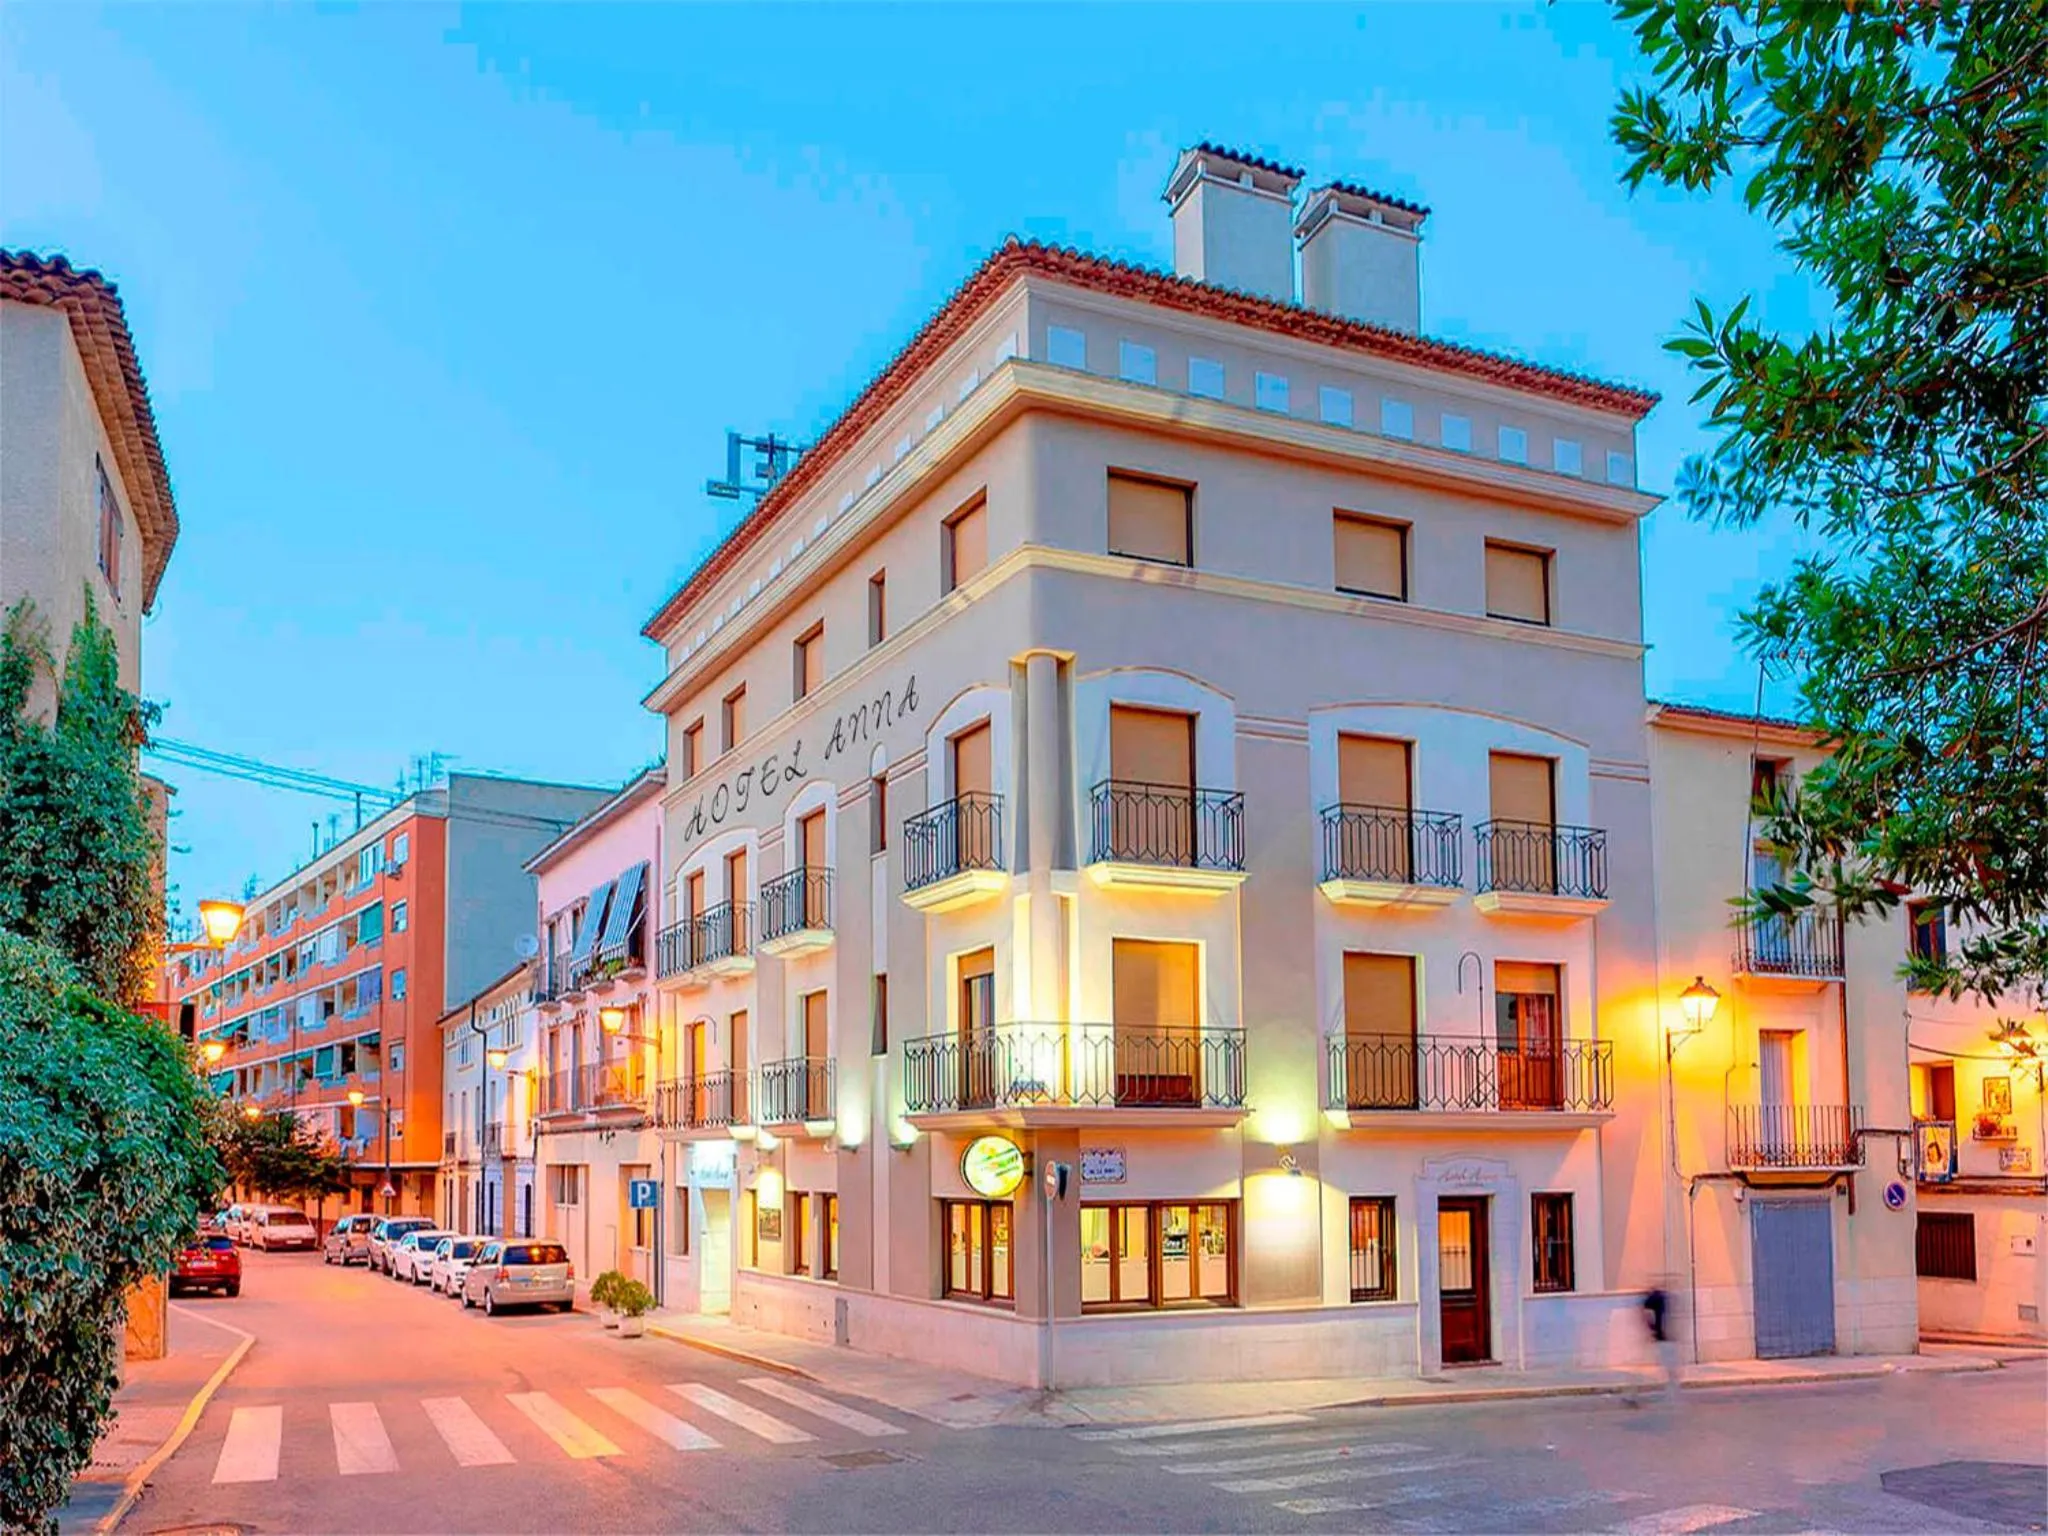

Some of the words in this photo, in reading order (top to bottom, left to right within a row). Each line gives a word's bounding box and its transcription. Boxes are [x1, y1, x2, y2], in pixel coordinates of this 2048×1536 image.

[684, 739, 808, 842] HOTEL
[824, 674, 920, 760] ANNA
[637, 1182, 651, 1206] P
